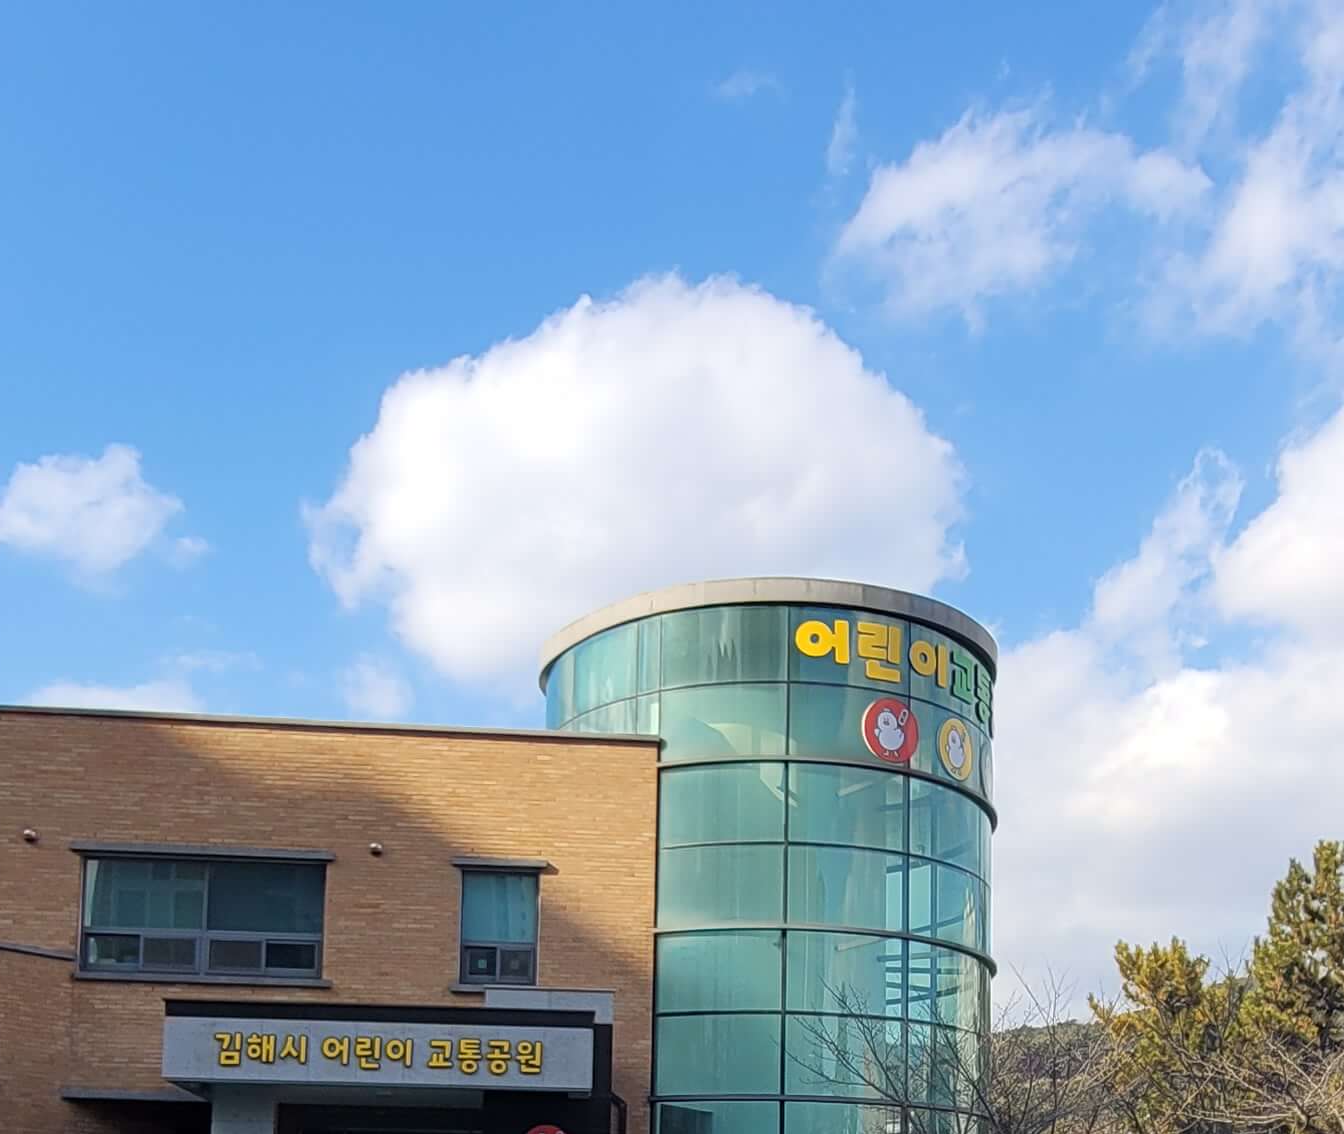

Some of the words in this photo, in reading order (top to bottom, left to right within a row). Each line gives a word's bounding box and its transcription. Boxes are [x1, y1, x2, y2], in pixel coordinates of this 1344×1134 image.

[214, 1031, 307, 1066] 김해시
[321, 1035, 414, 1070] 어린이
[427, 1038, 544, 1075] 교통공원
